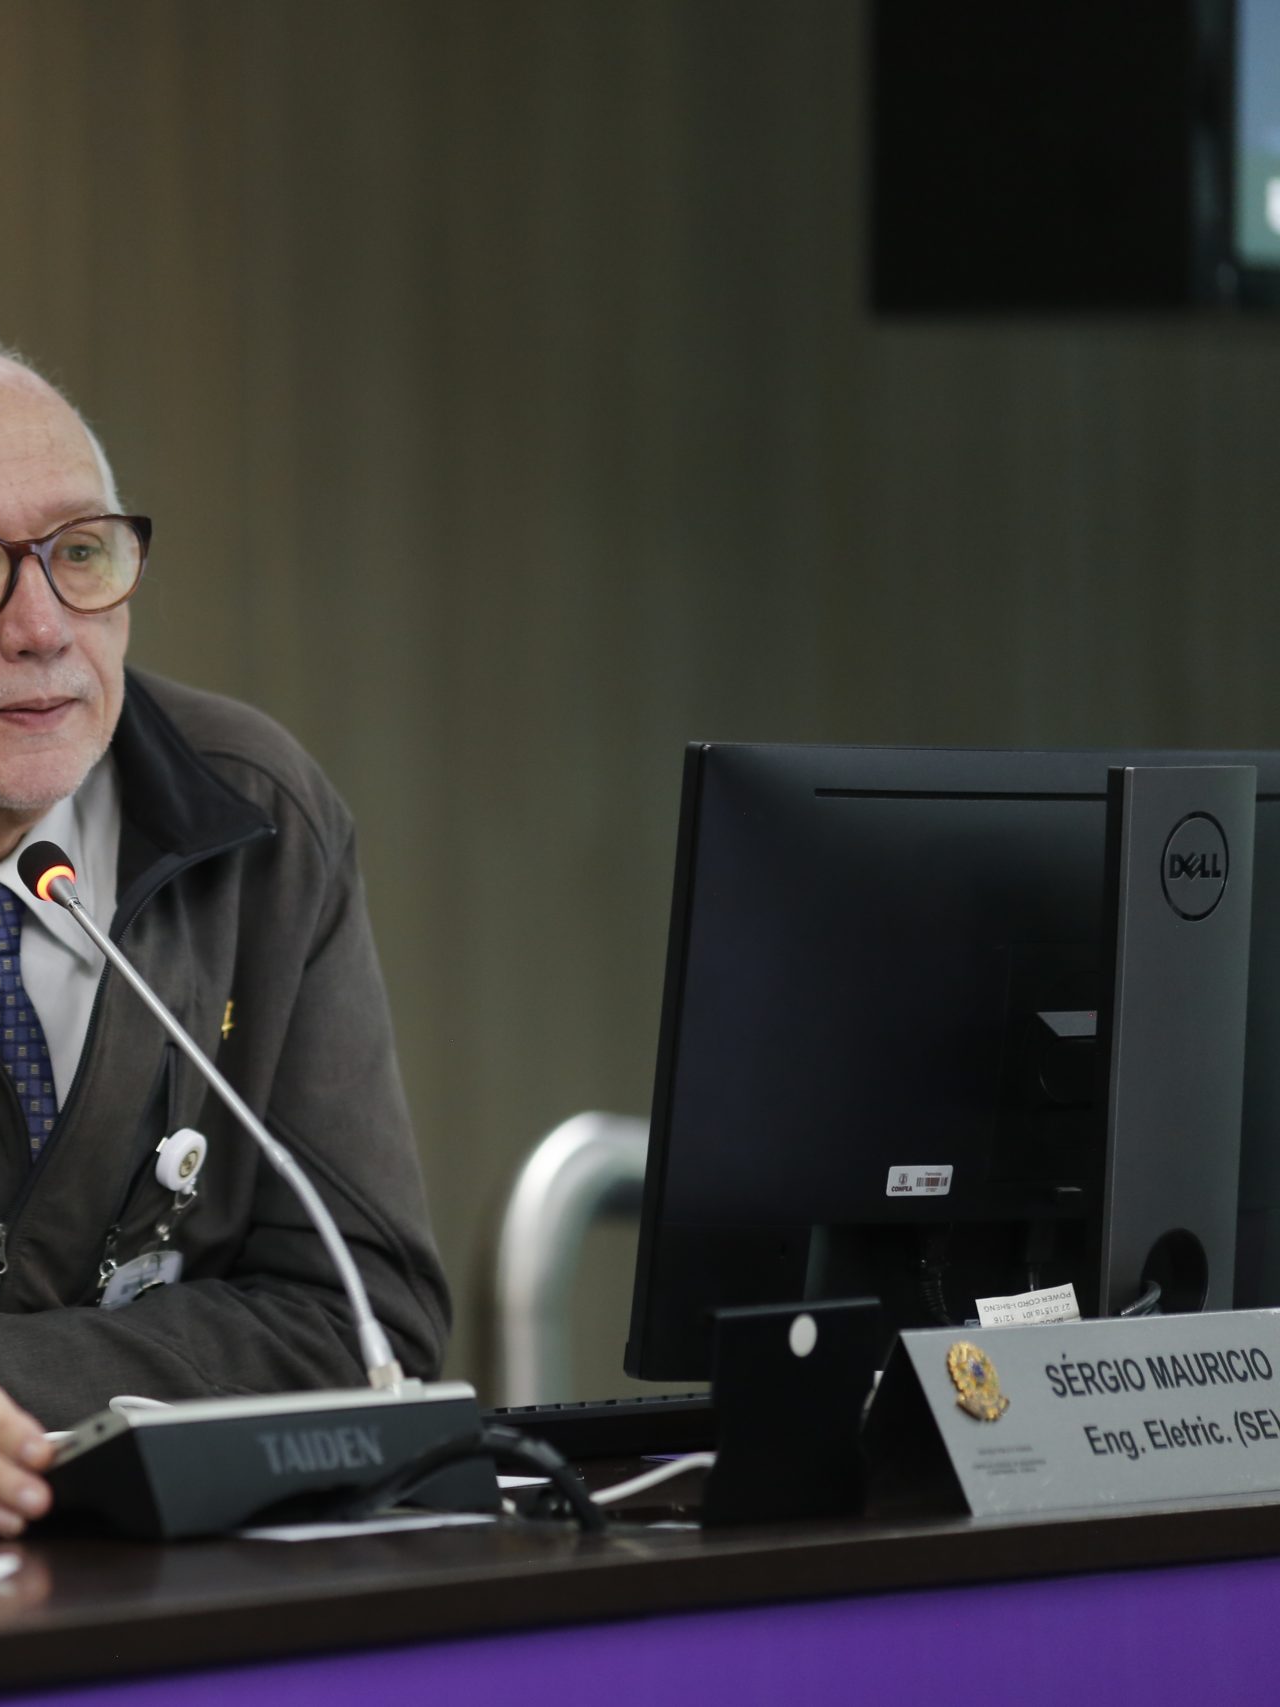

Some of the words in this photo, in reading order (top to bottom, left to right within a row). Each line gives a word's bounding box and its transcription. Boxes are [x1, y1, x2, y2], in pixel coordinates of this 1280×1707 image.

[1168, 852, 1222, 881] DELL
[1017, 1297, 1041, 1308] CORD
[1040, 1292, 1072, 1303] POWER
[1045, 1353, 1146, 1399] SÉRGIO
[1145, 1348, 1273, 1390] MAURICIO
[257, 1425, 384, 1475] TAIDEN
[1083, 1426, 1147, 1461] Eng.
[1143, 1416, 1243, 1450] Eletric.
